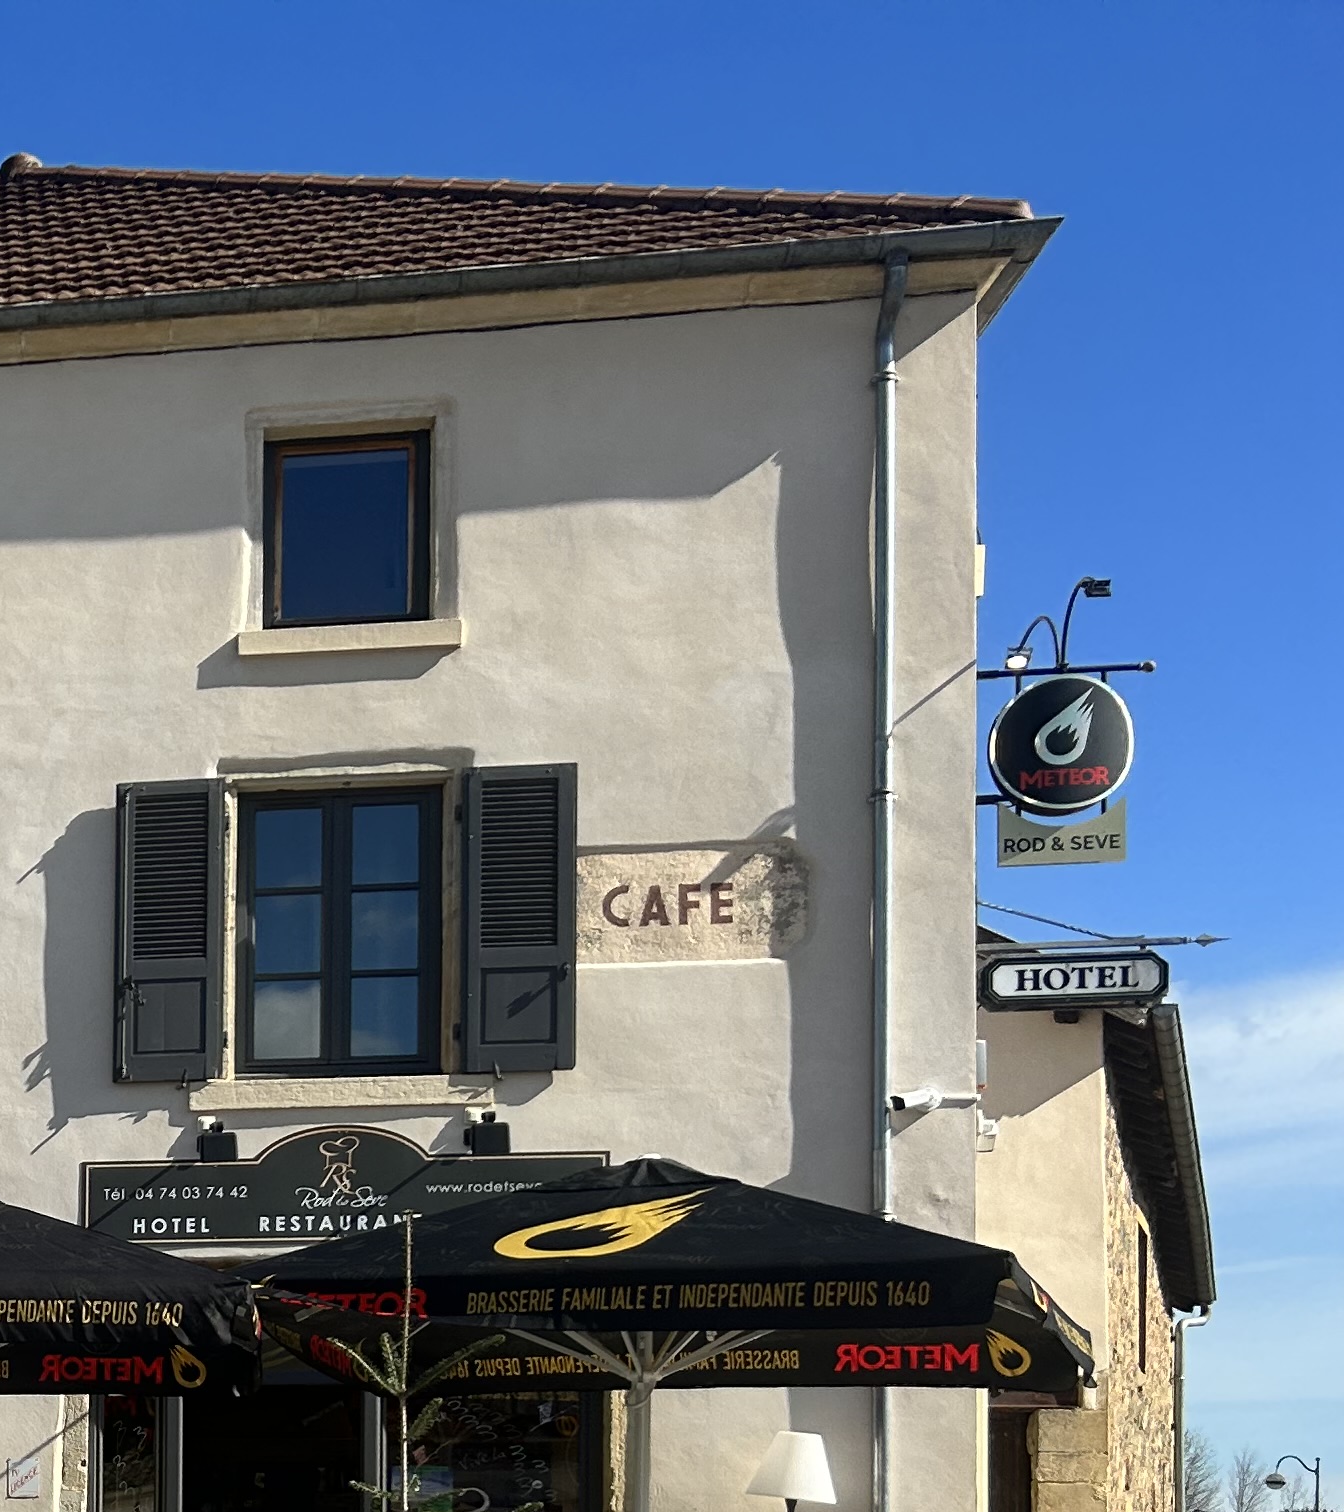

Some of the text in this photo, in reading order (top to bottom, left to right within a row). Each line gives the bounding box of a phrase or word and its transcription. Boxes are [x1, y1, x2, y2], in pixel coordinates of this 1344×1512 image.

[1019, 766, 1111, 791] METEOR
[1003, 834, 1121, 853] ROD & SEVE
[602, 882, 734, 927] CAFE
[1015, 965, 1139, 992] HOTEL
[135, 1187, 154, 1200] 04
[159, 1187, 177, 1200] 74
[182, 1186, 201, 1199] 03
[206, 1186, 224, 1199] 74
[229, 1185, 248, 1198] 42
[133, 1217, 210, 1234] HOTEL
[258, 1214, 422, 1233] RESTAURAN
[282, 1287, 430, 1319] TEOR
[466, 1280, 931, 1315] BRASSERIE FAMILIALE ET INDEPENDANTE DEPUIS 1640
[81, 1300, 138, 1325] DEPUIS
[145, 1302, 184, 1327] 1640
